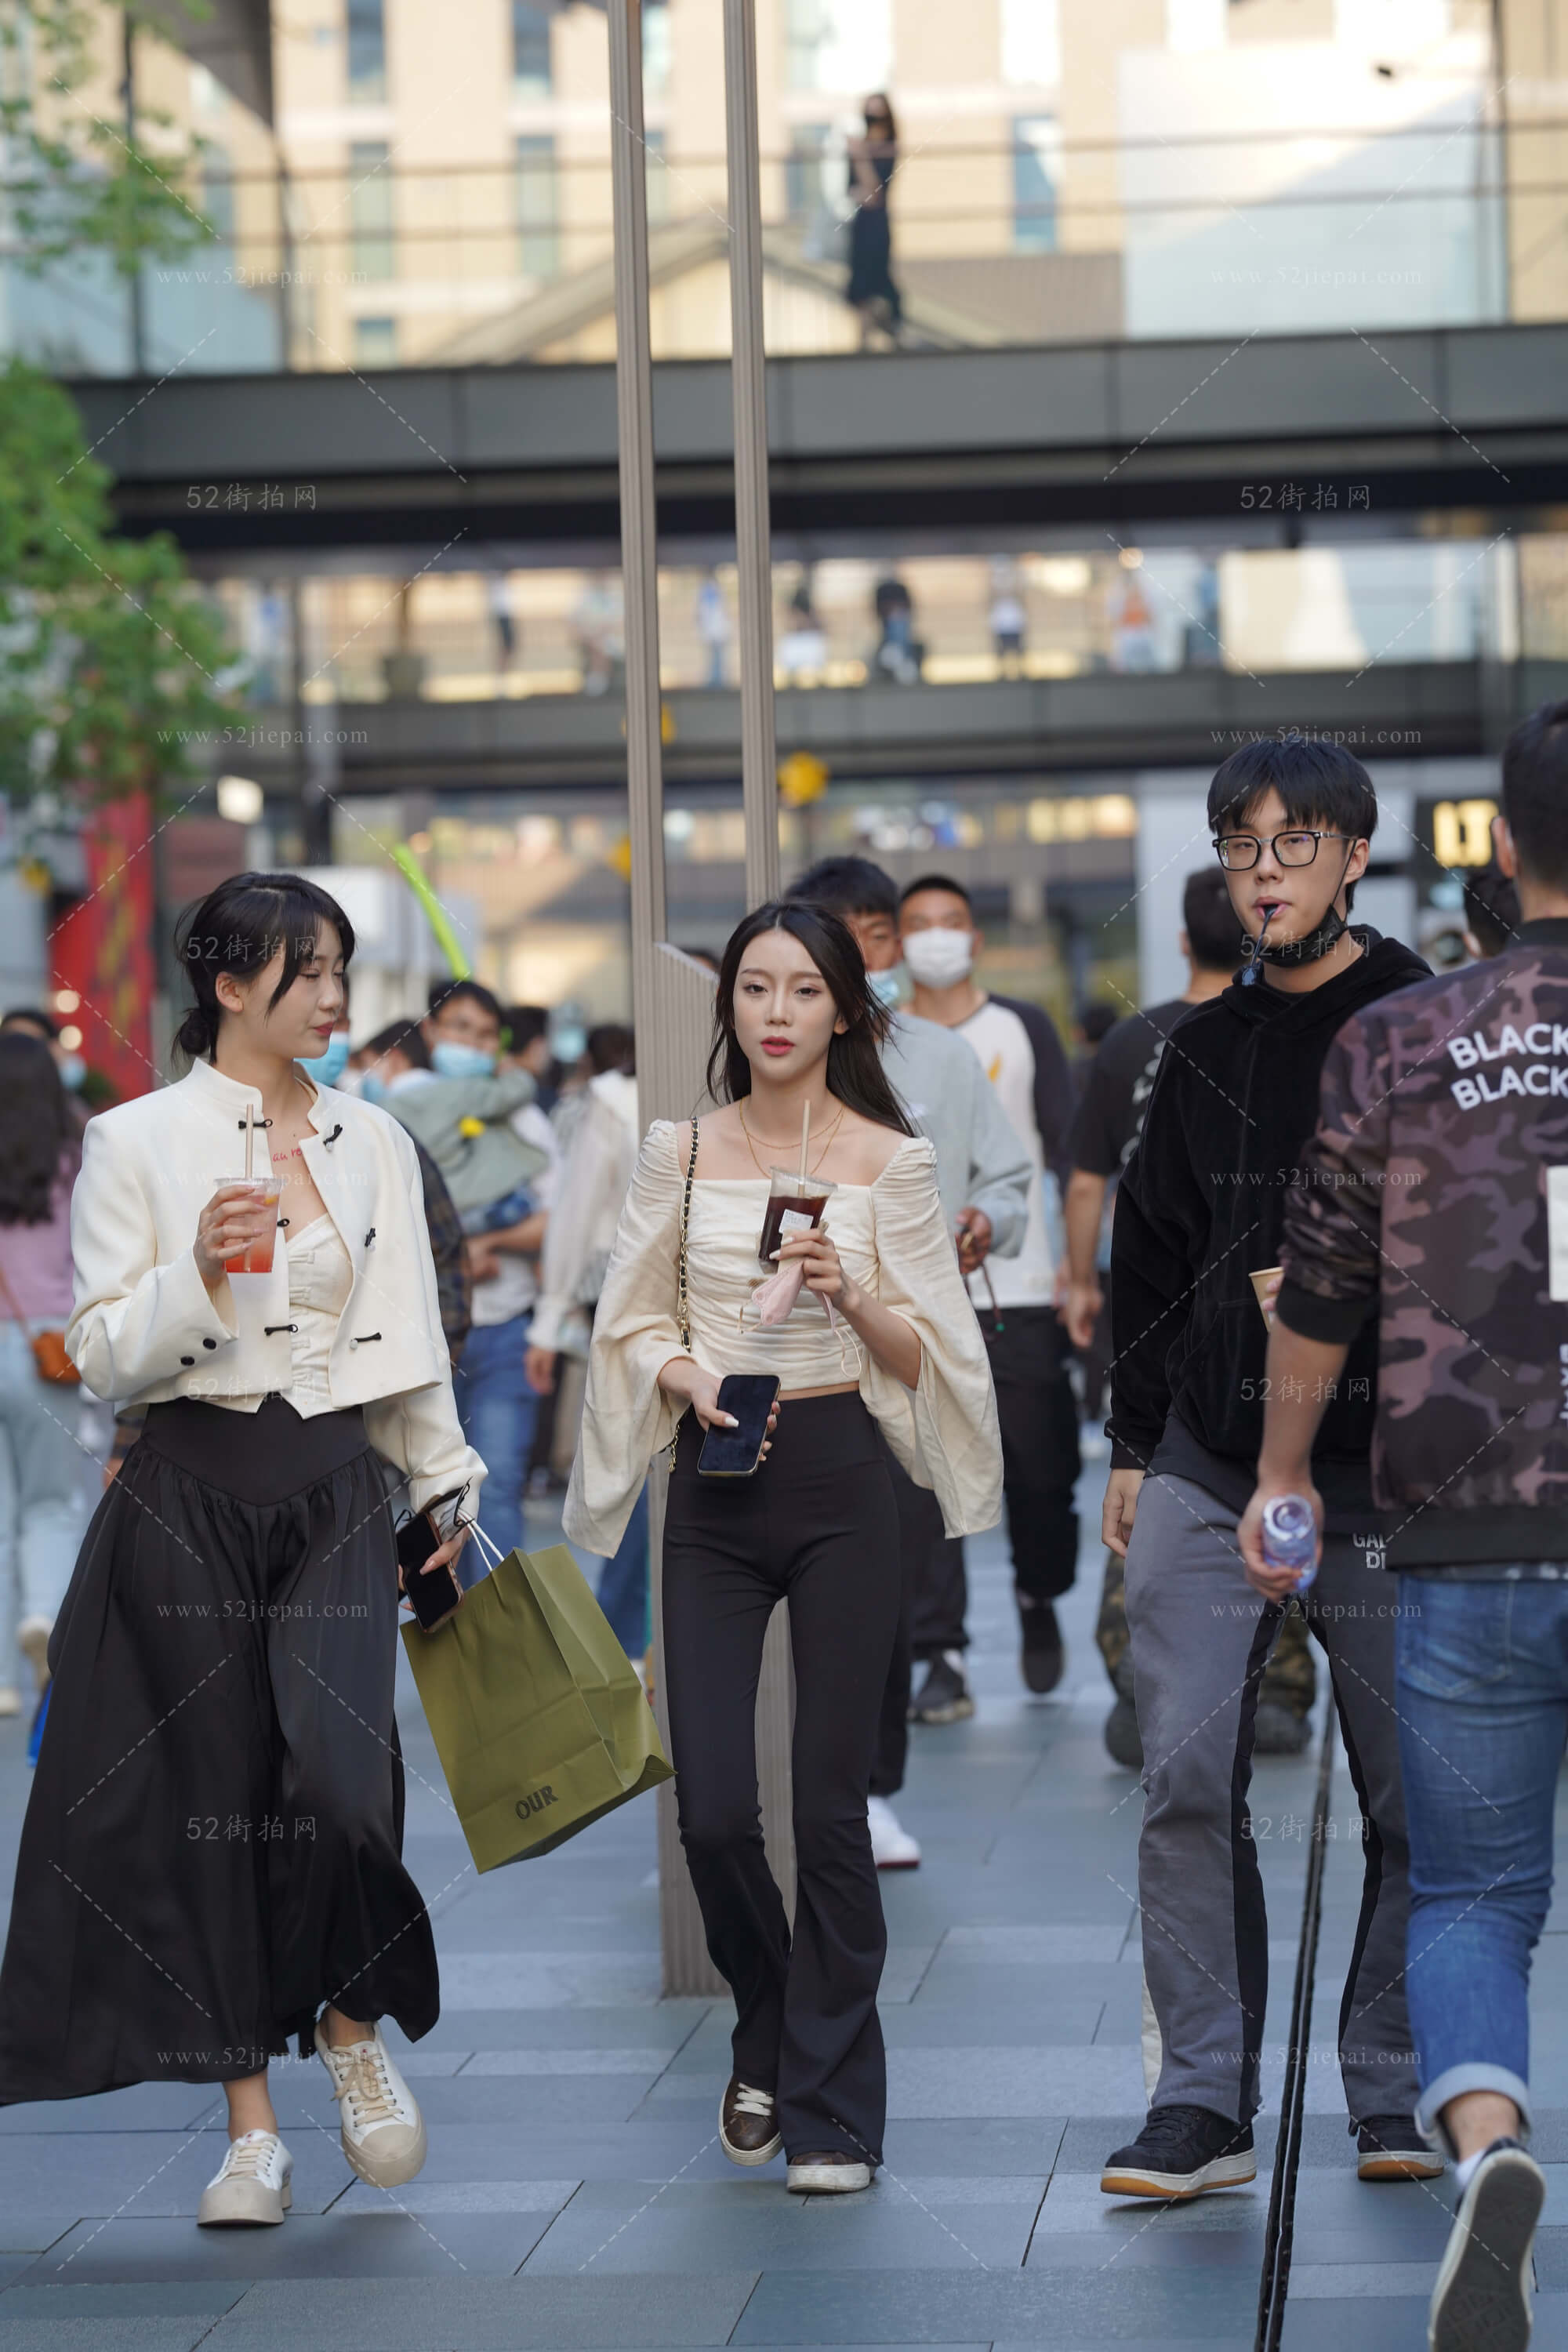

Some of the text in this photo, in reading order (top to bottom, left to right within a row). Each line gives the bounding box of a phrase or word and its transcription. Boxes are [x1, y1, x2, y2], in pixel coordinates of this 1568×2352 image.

[1447, 1023, 1568, 1070] BLACK
[1451, 1064, 1568, 1111] BLACK
[515, 1785, 559, 1820] OUR
